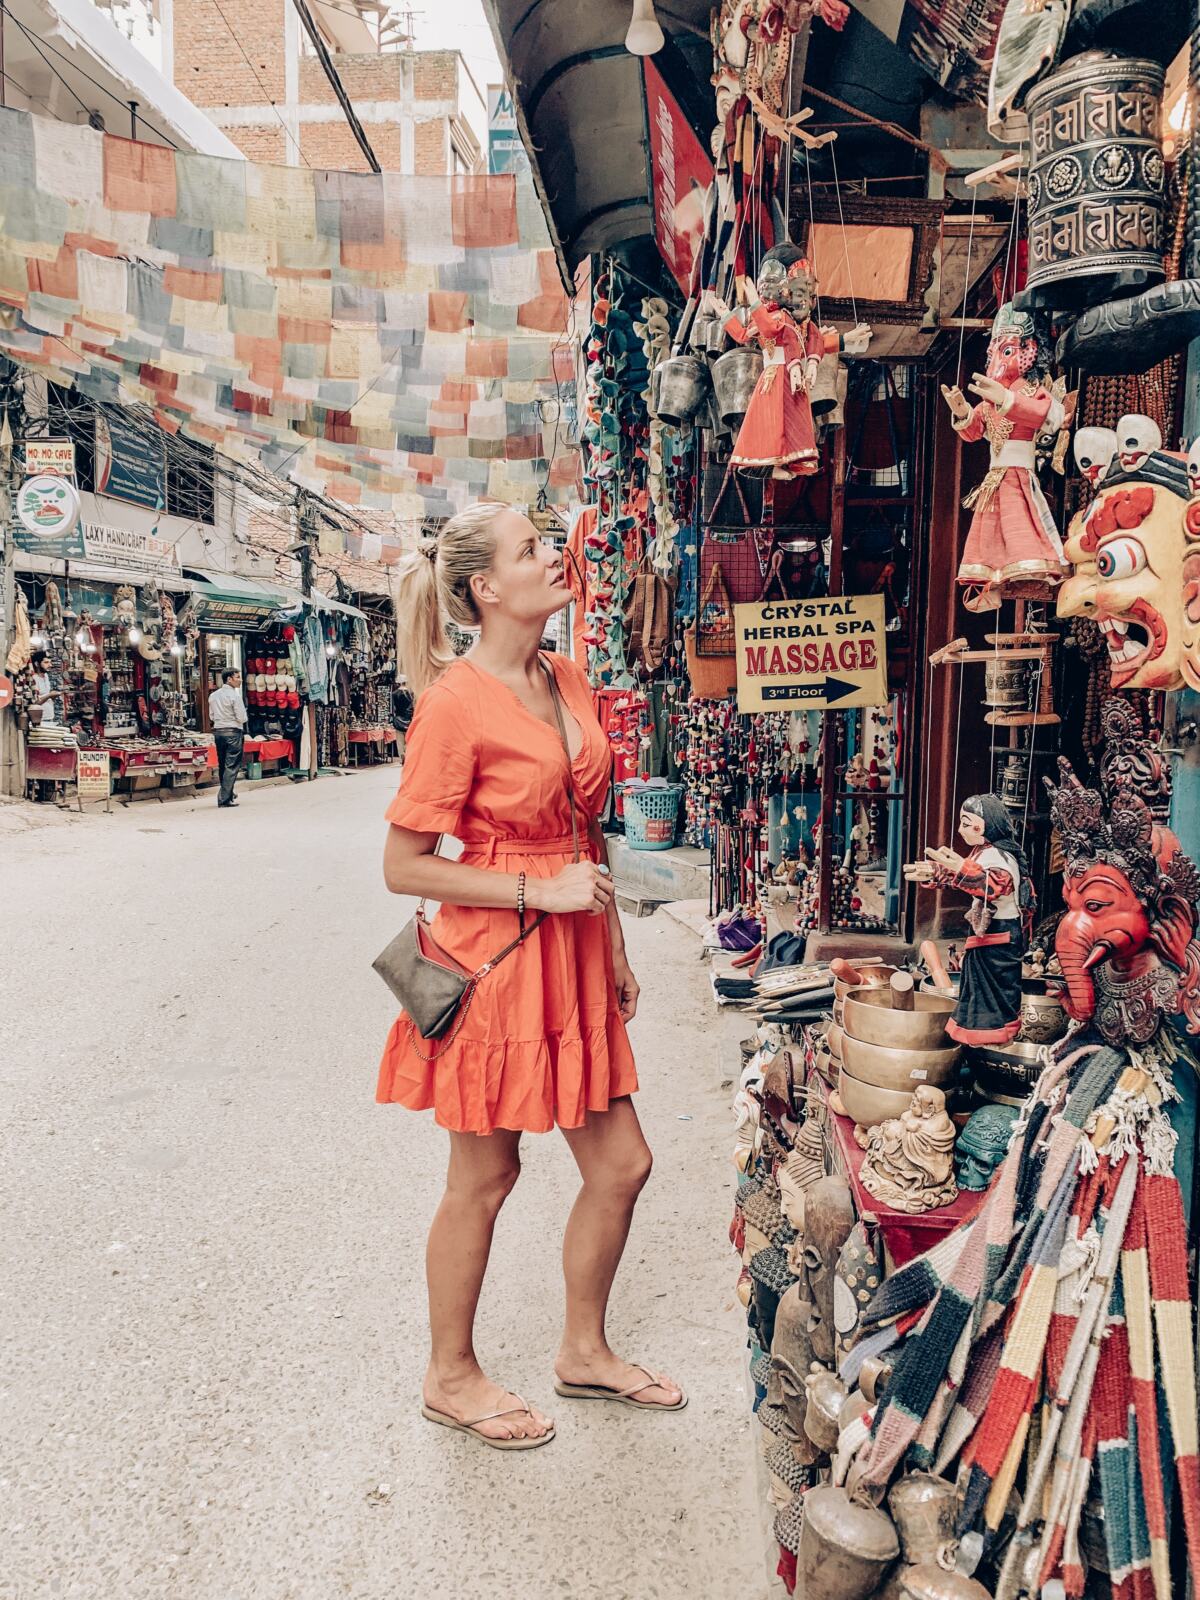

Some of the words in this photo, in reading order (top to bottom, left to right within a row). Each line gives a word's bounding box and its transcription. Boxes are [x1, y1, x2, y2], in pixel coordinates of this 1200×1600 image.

[958, 0, 987, 43] Mata
[55, 449, 72, 460] CAVE
[85, 525, 104, 542] LAXY
[106, 528, 147, 551] HANDICRAFT
[761, 602, 856, 620] CRYSTAL
[744, 624, 828, 640] HERBAL
[835, 620, 876, 635] SPA
[745, 639, 877, 676] MASSAGE
[768, 689, 785, 698] 3rd
[788, 687, 824, 697] Floor
[80, 753, 108, 761] LAUNDRY
[79, 767, 101, 777] 100
